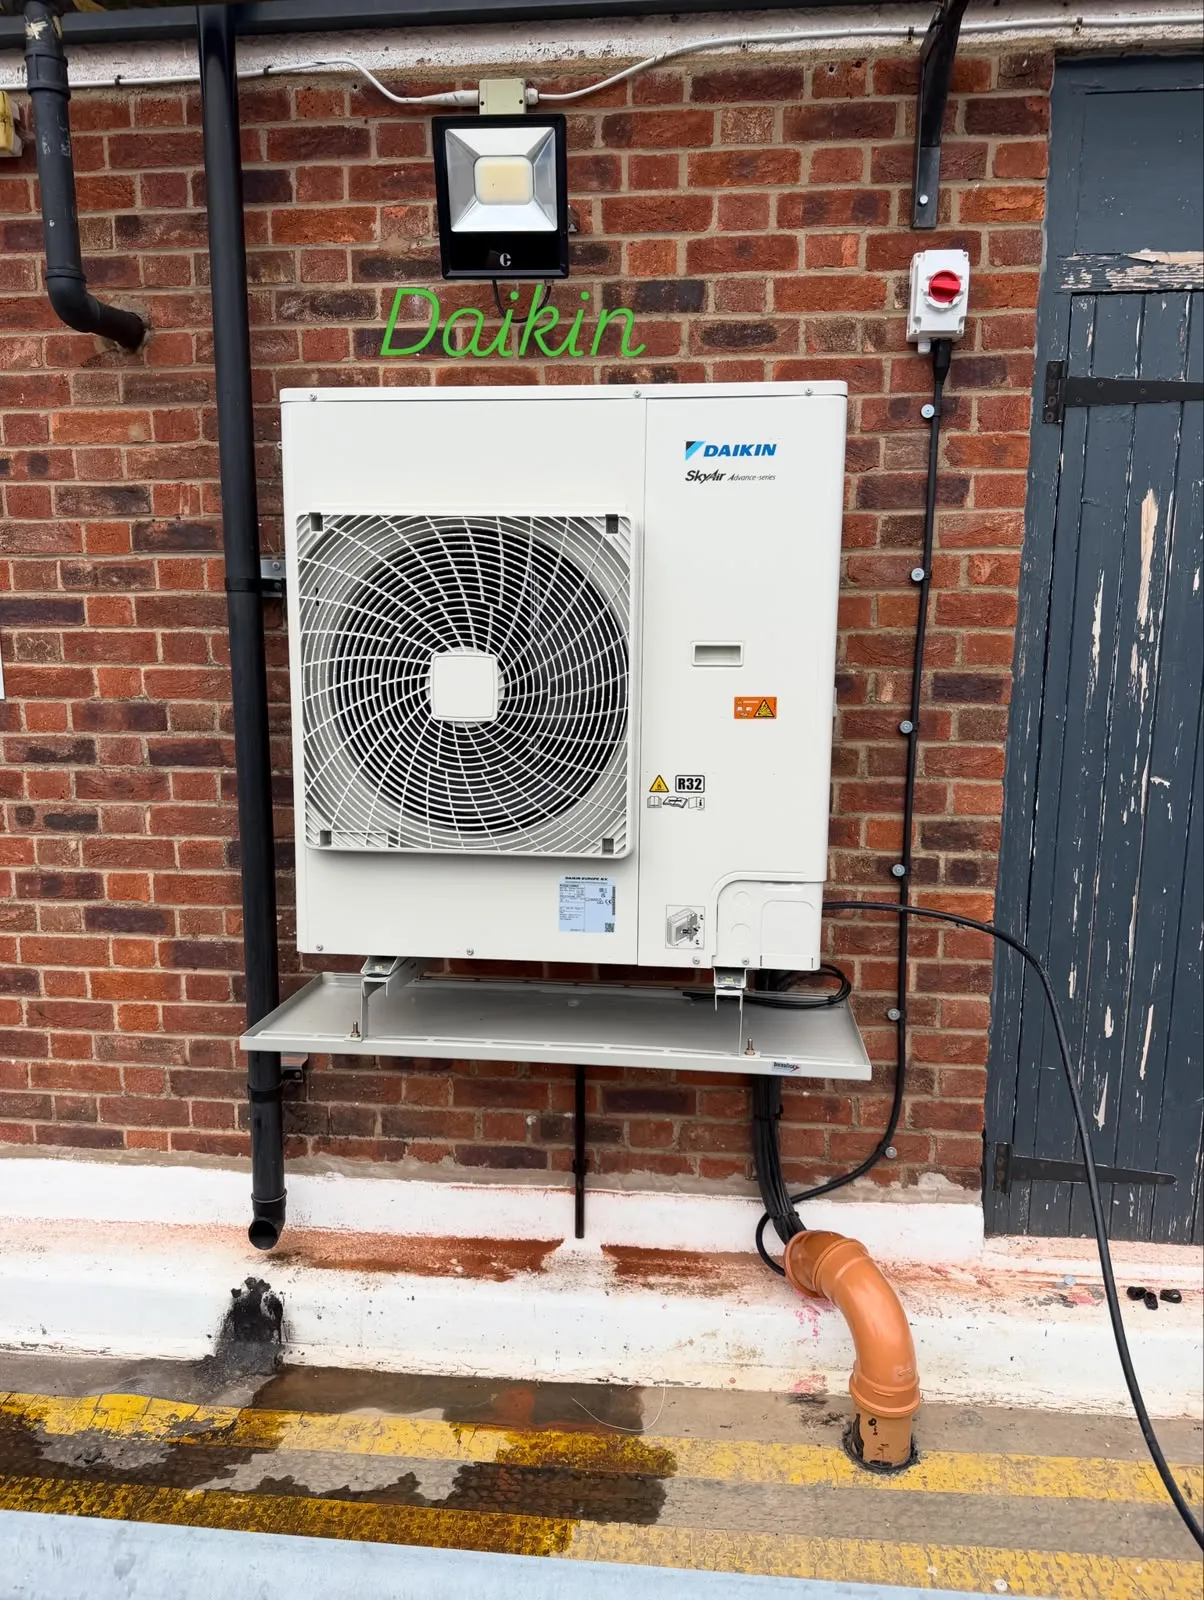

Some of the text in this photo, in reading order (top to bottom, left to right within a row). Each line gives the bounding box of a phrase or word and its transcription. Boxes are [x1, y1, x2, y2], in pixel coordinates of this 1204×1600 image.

[703, 443, 777, 457] DAIKIN
[685, 469, 726, 484] SkyAir
[677, 777, 703, 791] R32
